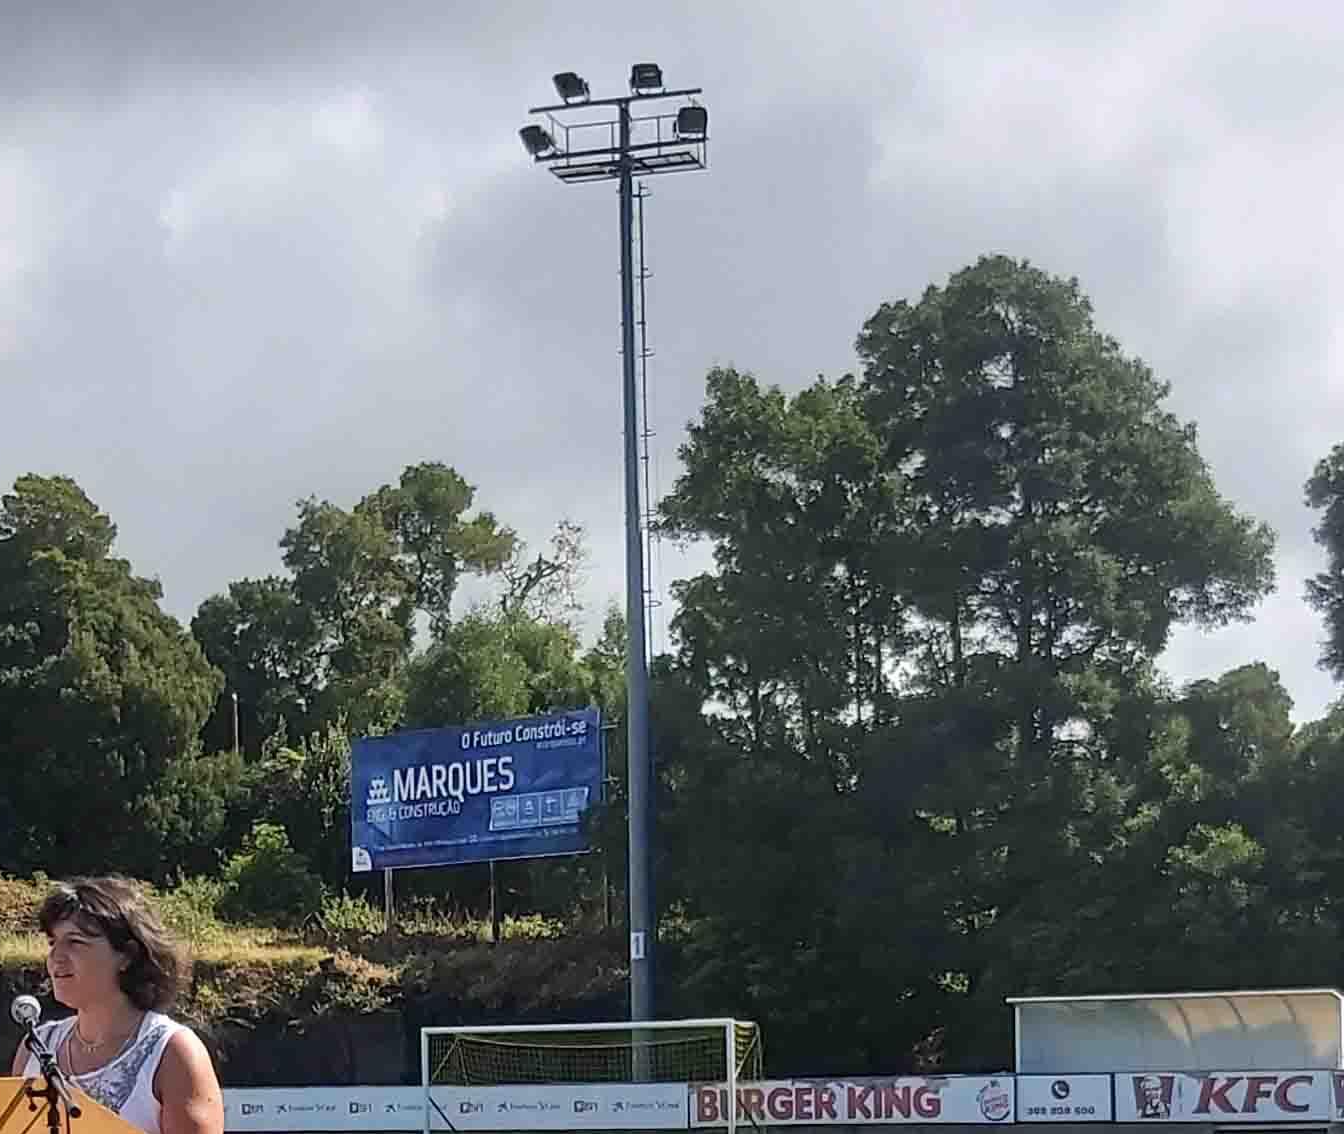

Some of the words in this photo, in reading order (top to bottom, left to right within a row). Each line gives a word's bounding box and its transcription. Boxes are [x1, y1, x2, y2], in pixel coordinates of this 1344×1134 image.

[461, 733, 470, 749] O
[473, 730, 512, 748] Futuro
[515, 718, 587, 742] Constrói-se
[393, 756, 515, 802] MARQUES
[696, 1086, 839, 1122] BURGER
[847, 1085, 942, 1120] KING
[1192, 1074, 1313, 1115] KFC
